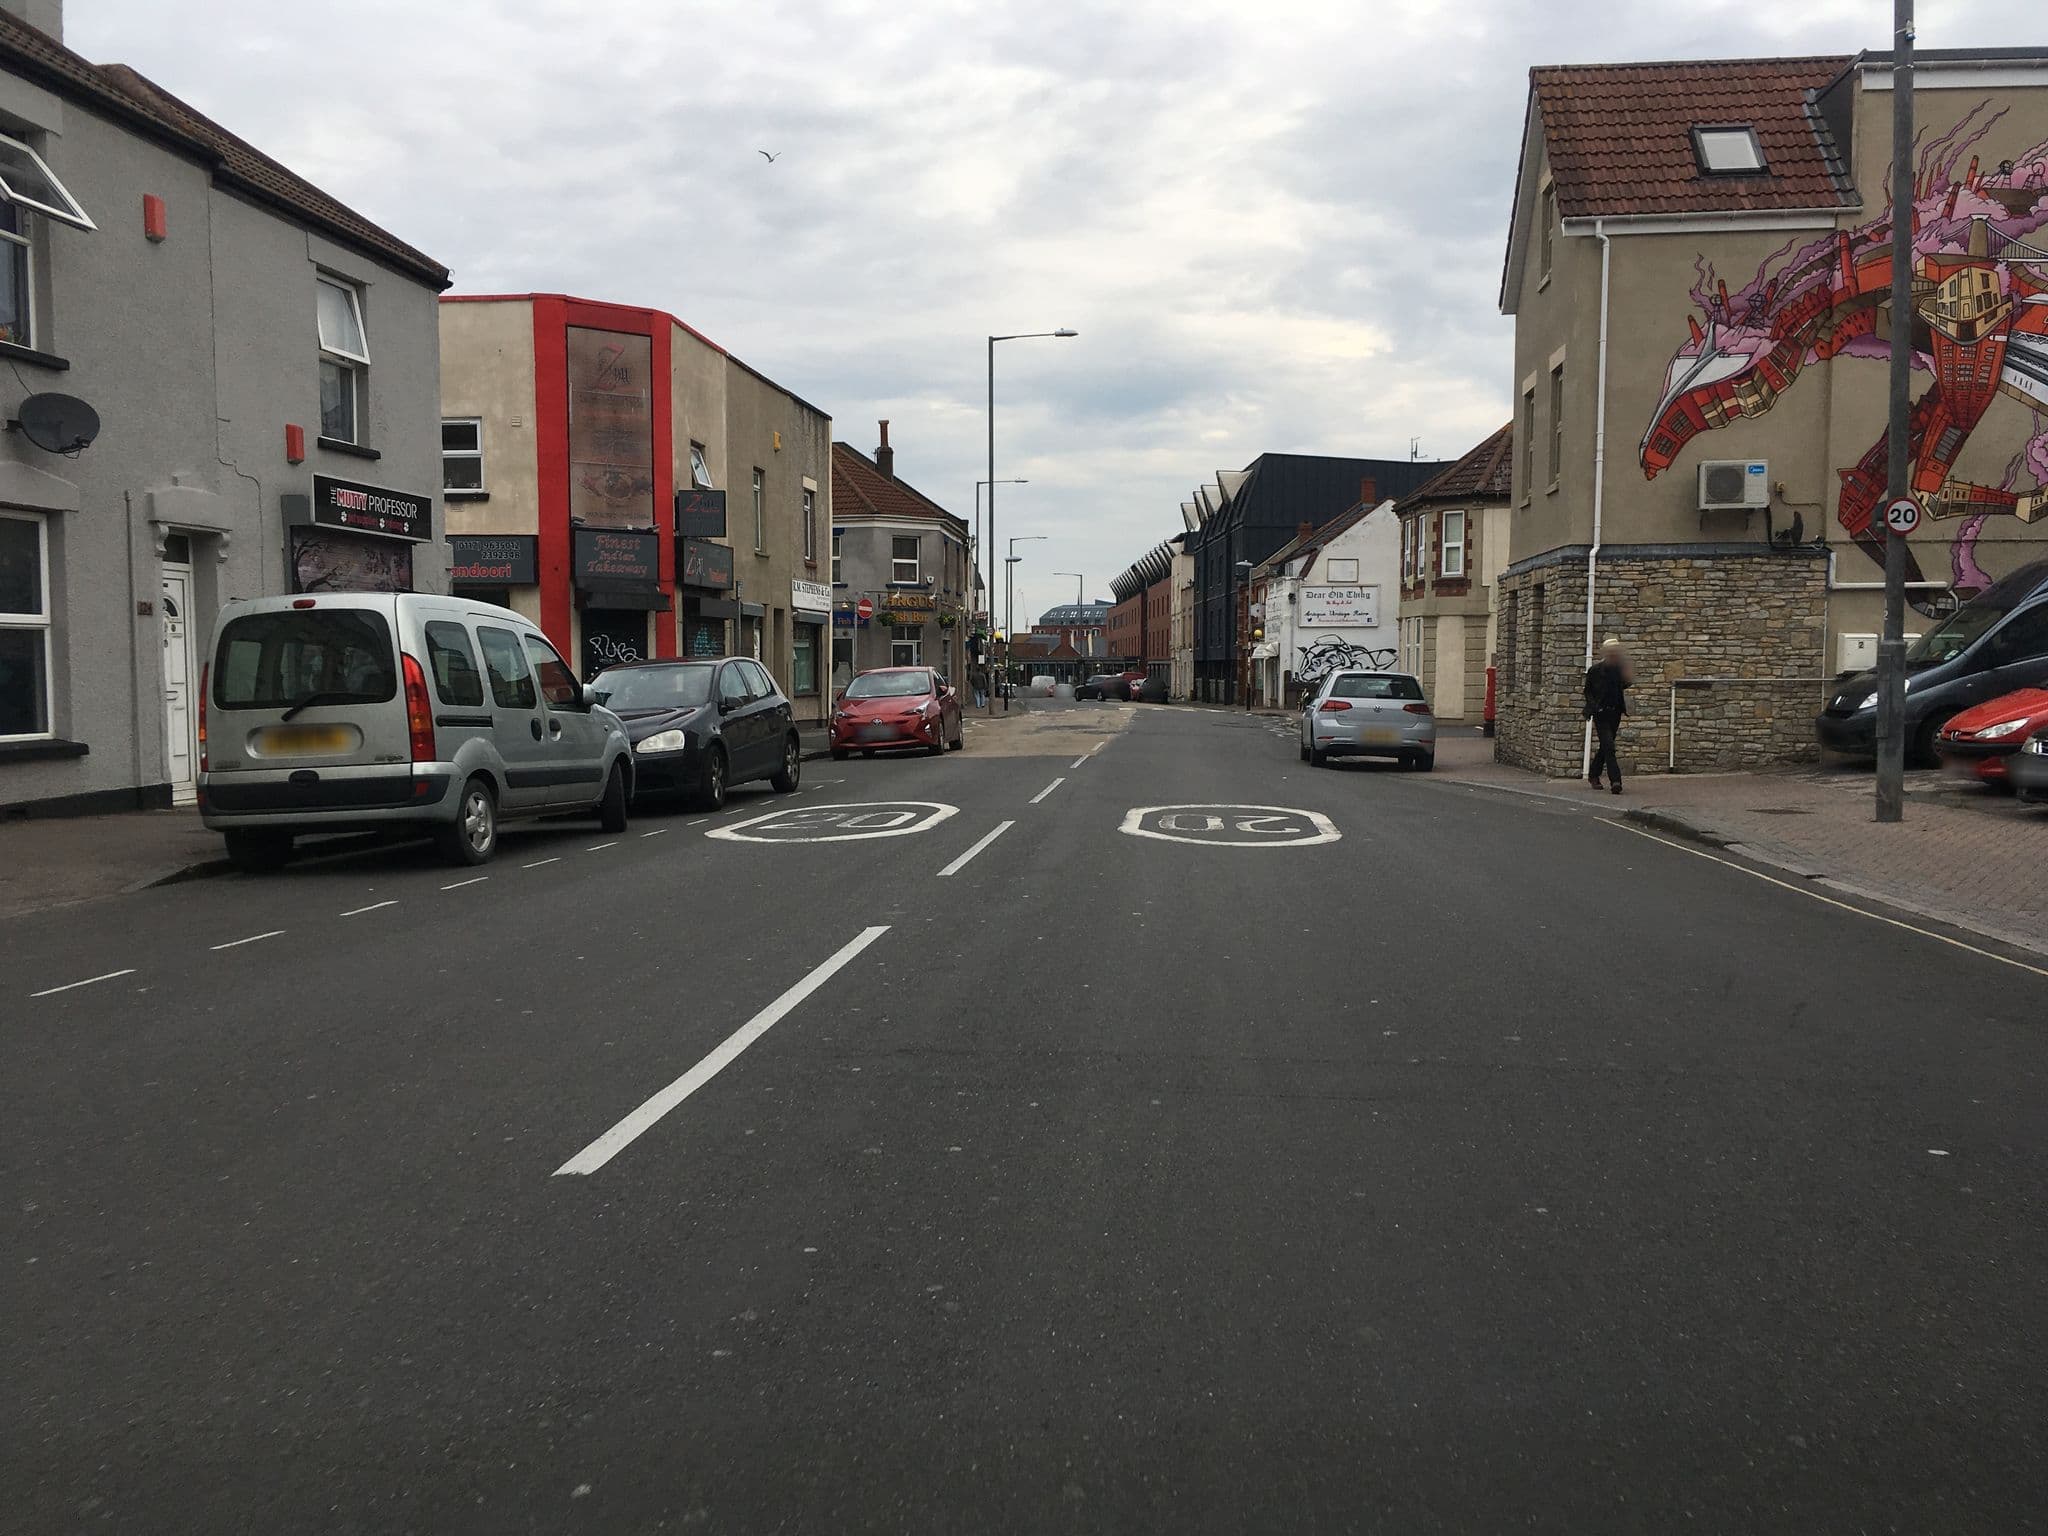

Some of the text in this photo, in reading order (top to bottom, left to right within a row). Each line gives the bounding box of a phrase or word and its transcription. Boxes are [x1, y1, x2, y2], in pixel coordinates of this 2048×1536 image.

[368, 495, 418, 520] PROFESSOR
[1890, 508, 1916, 524] 20
[1305, 591, 1326, 599] Dear
[1328, 591, 1344, 599] Old
[1858, 641, 1864, 649] 2
